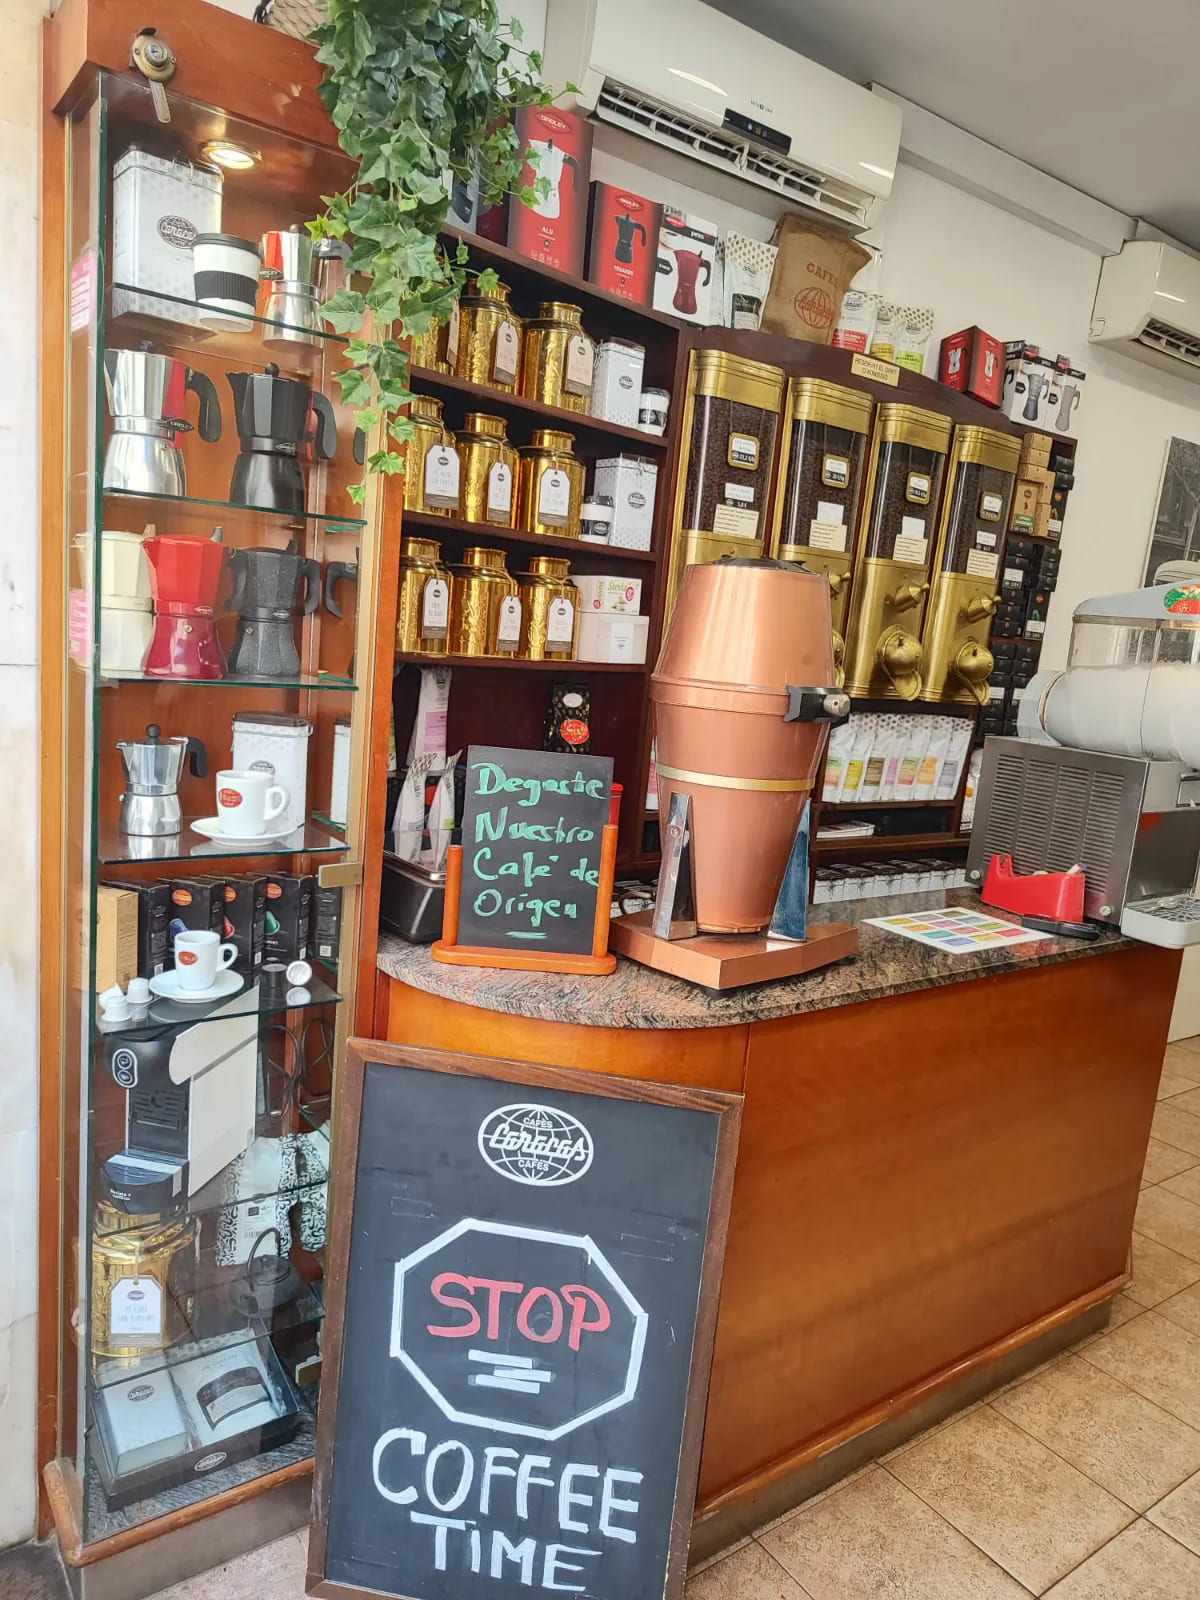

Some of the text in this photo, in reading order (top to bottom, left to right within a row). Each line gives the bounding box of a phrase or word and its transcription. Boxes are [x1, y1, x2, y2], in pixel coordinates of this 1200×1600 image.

[475, 806, 594, 844] Nuestro
[473, 847, 599, 887] Café de
[427, 1272, 611, 1351] STOP
[372, 1431, 644, 1544] COFFEE
[410, 1511, 603, 1592] TIME
